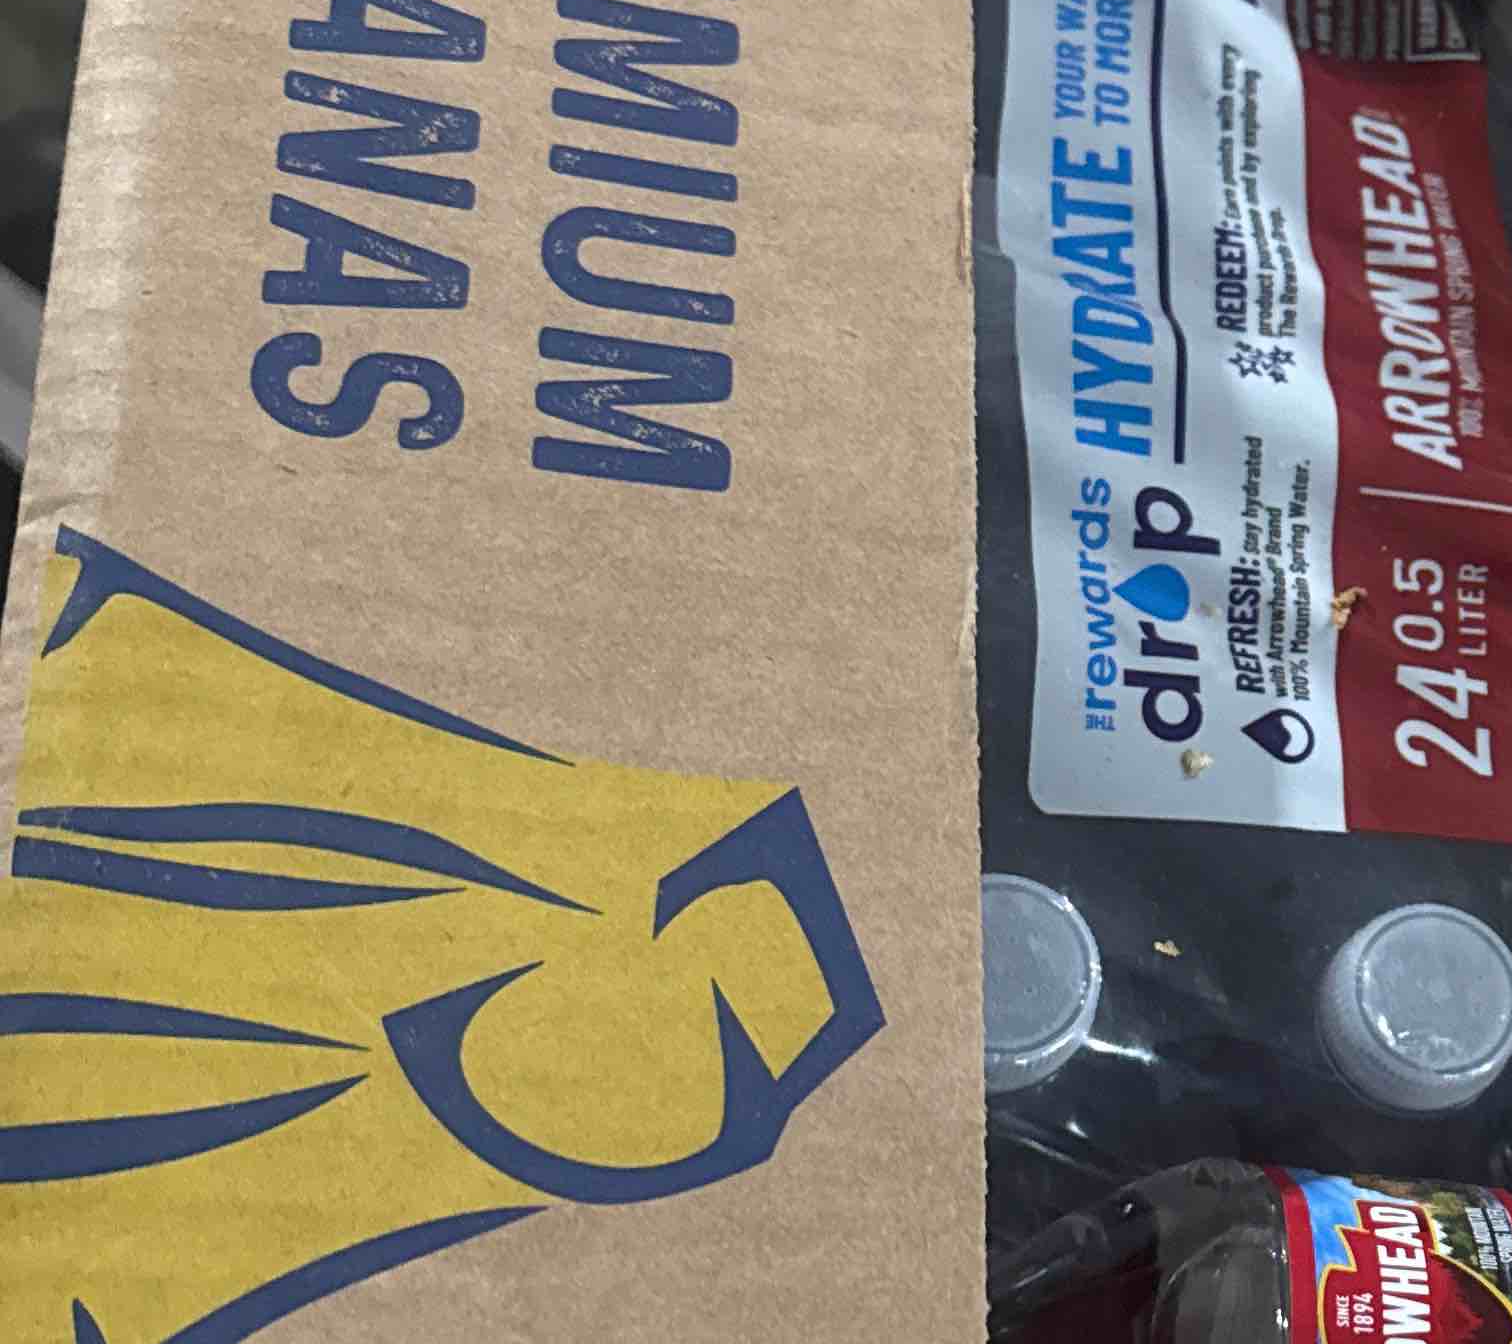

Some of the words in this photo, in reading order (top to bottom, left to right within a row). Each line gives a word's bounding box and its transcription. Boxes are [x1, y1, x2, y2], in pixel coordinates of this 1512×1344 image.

[1054, 40, 1087, 121] YOUR
[1095, 83, 1132, 127] TO
[1050, 135, 1155, 458] HYDRATE
[1213, 220, 1248, 335] REDEEM:
[1350, 112, 1464, 471] ARROWHEAD
[1441, 234, 1475, 303] SPRING
[1256, 273, 1277, 338] product
[1279, 306, 1297, 338] The
[1242, 436, 1264, 518] hydrated
[1288, 459, 1312, 522] Water.
[1243, 519, 1263, 554] Stay
[1264, 506, 1283, 555] Brand
[1289, 524, 1313, 575] Spring
[1071, 477, 1118, 711] rewards
[1227, 556, 1265, 695] REFRESH:
[1289, 576, 1312, 654] Mountain
[1393, 558, 1444, 651] 0.5
[1457, 564, 1489, 656] LITER
[1265, 661, 1289, 698] with
[1289, 658, 1312, 701] 100%
[1393, 662, 1495, 777] 24
[1336, 1294, 1350, 1328] SINCE
[1352, 1292, 1375, 1335] 1894
